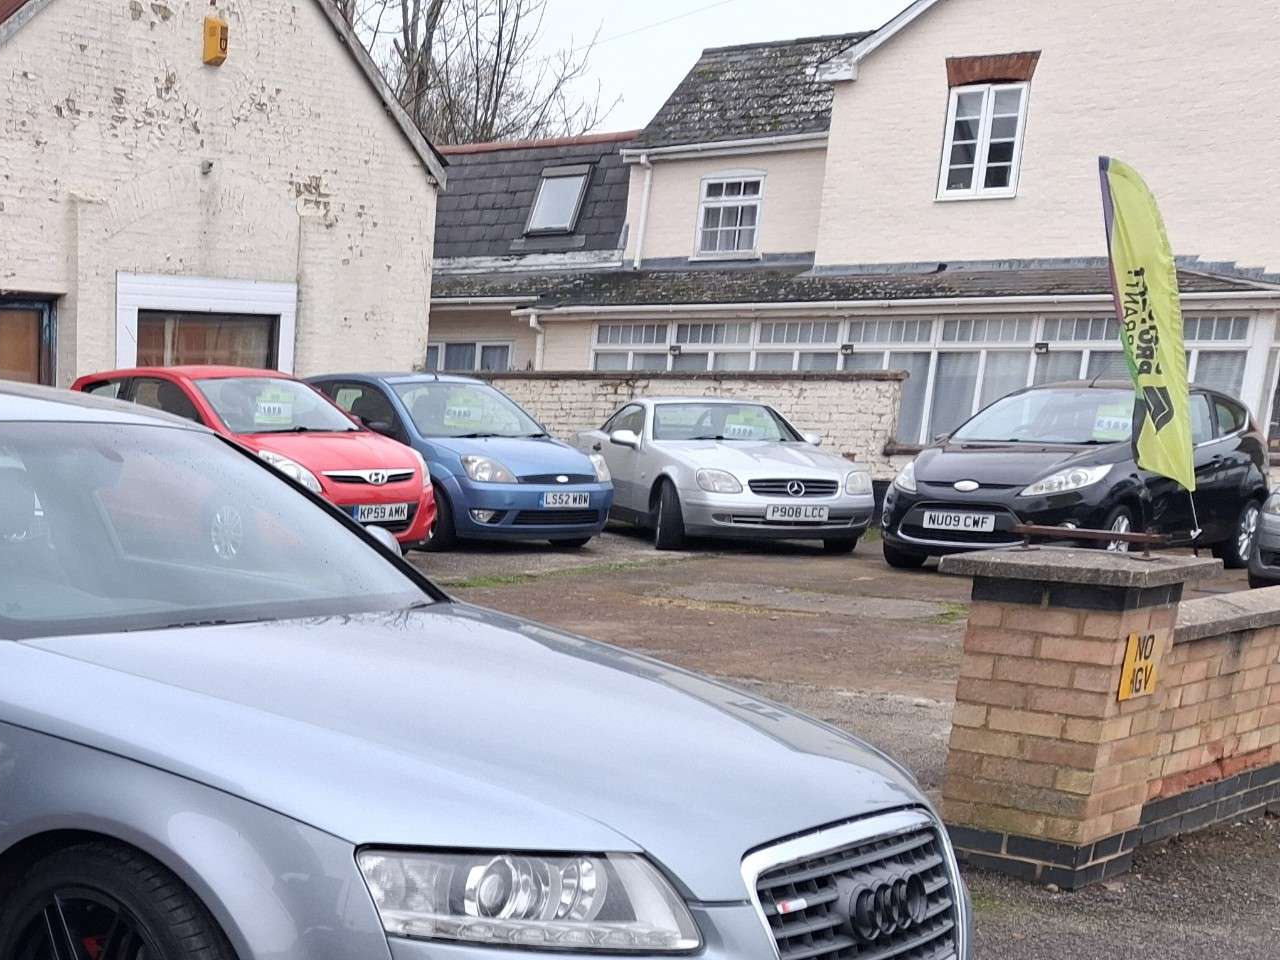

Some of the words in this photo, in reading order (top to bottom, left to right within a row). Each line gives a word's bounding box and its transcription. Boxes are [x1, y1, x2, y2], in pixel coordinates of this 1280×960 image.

[360, 505, 387, 520] KP59
[771, 506, 802, 518] P908
[804, 507, 825, 519] LCC
[928, 513, 961, 527] NU09
[963, 515, 990, 529] CWF
[1134, 633, 1156, 663] NO
